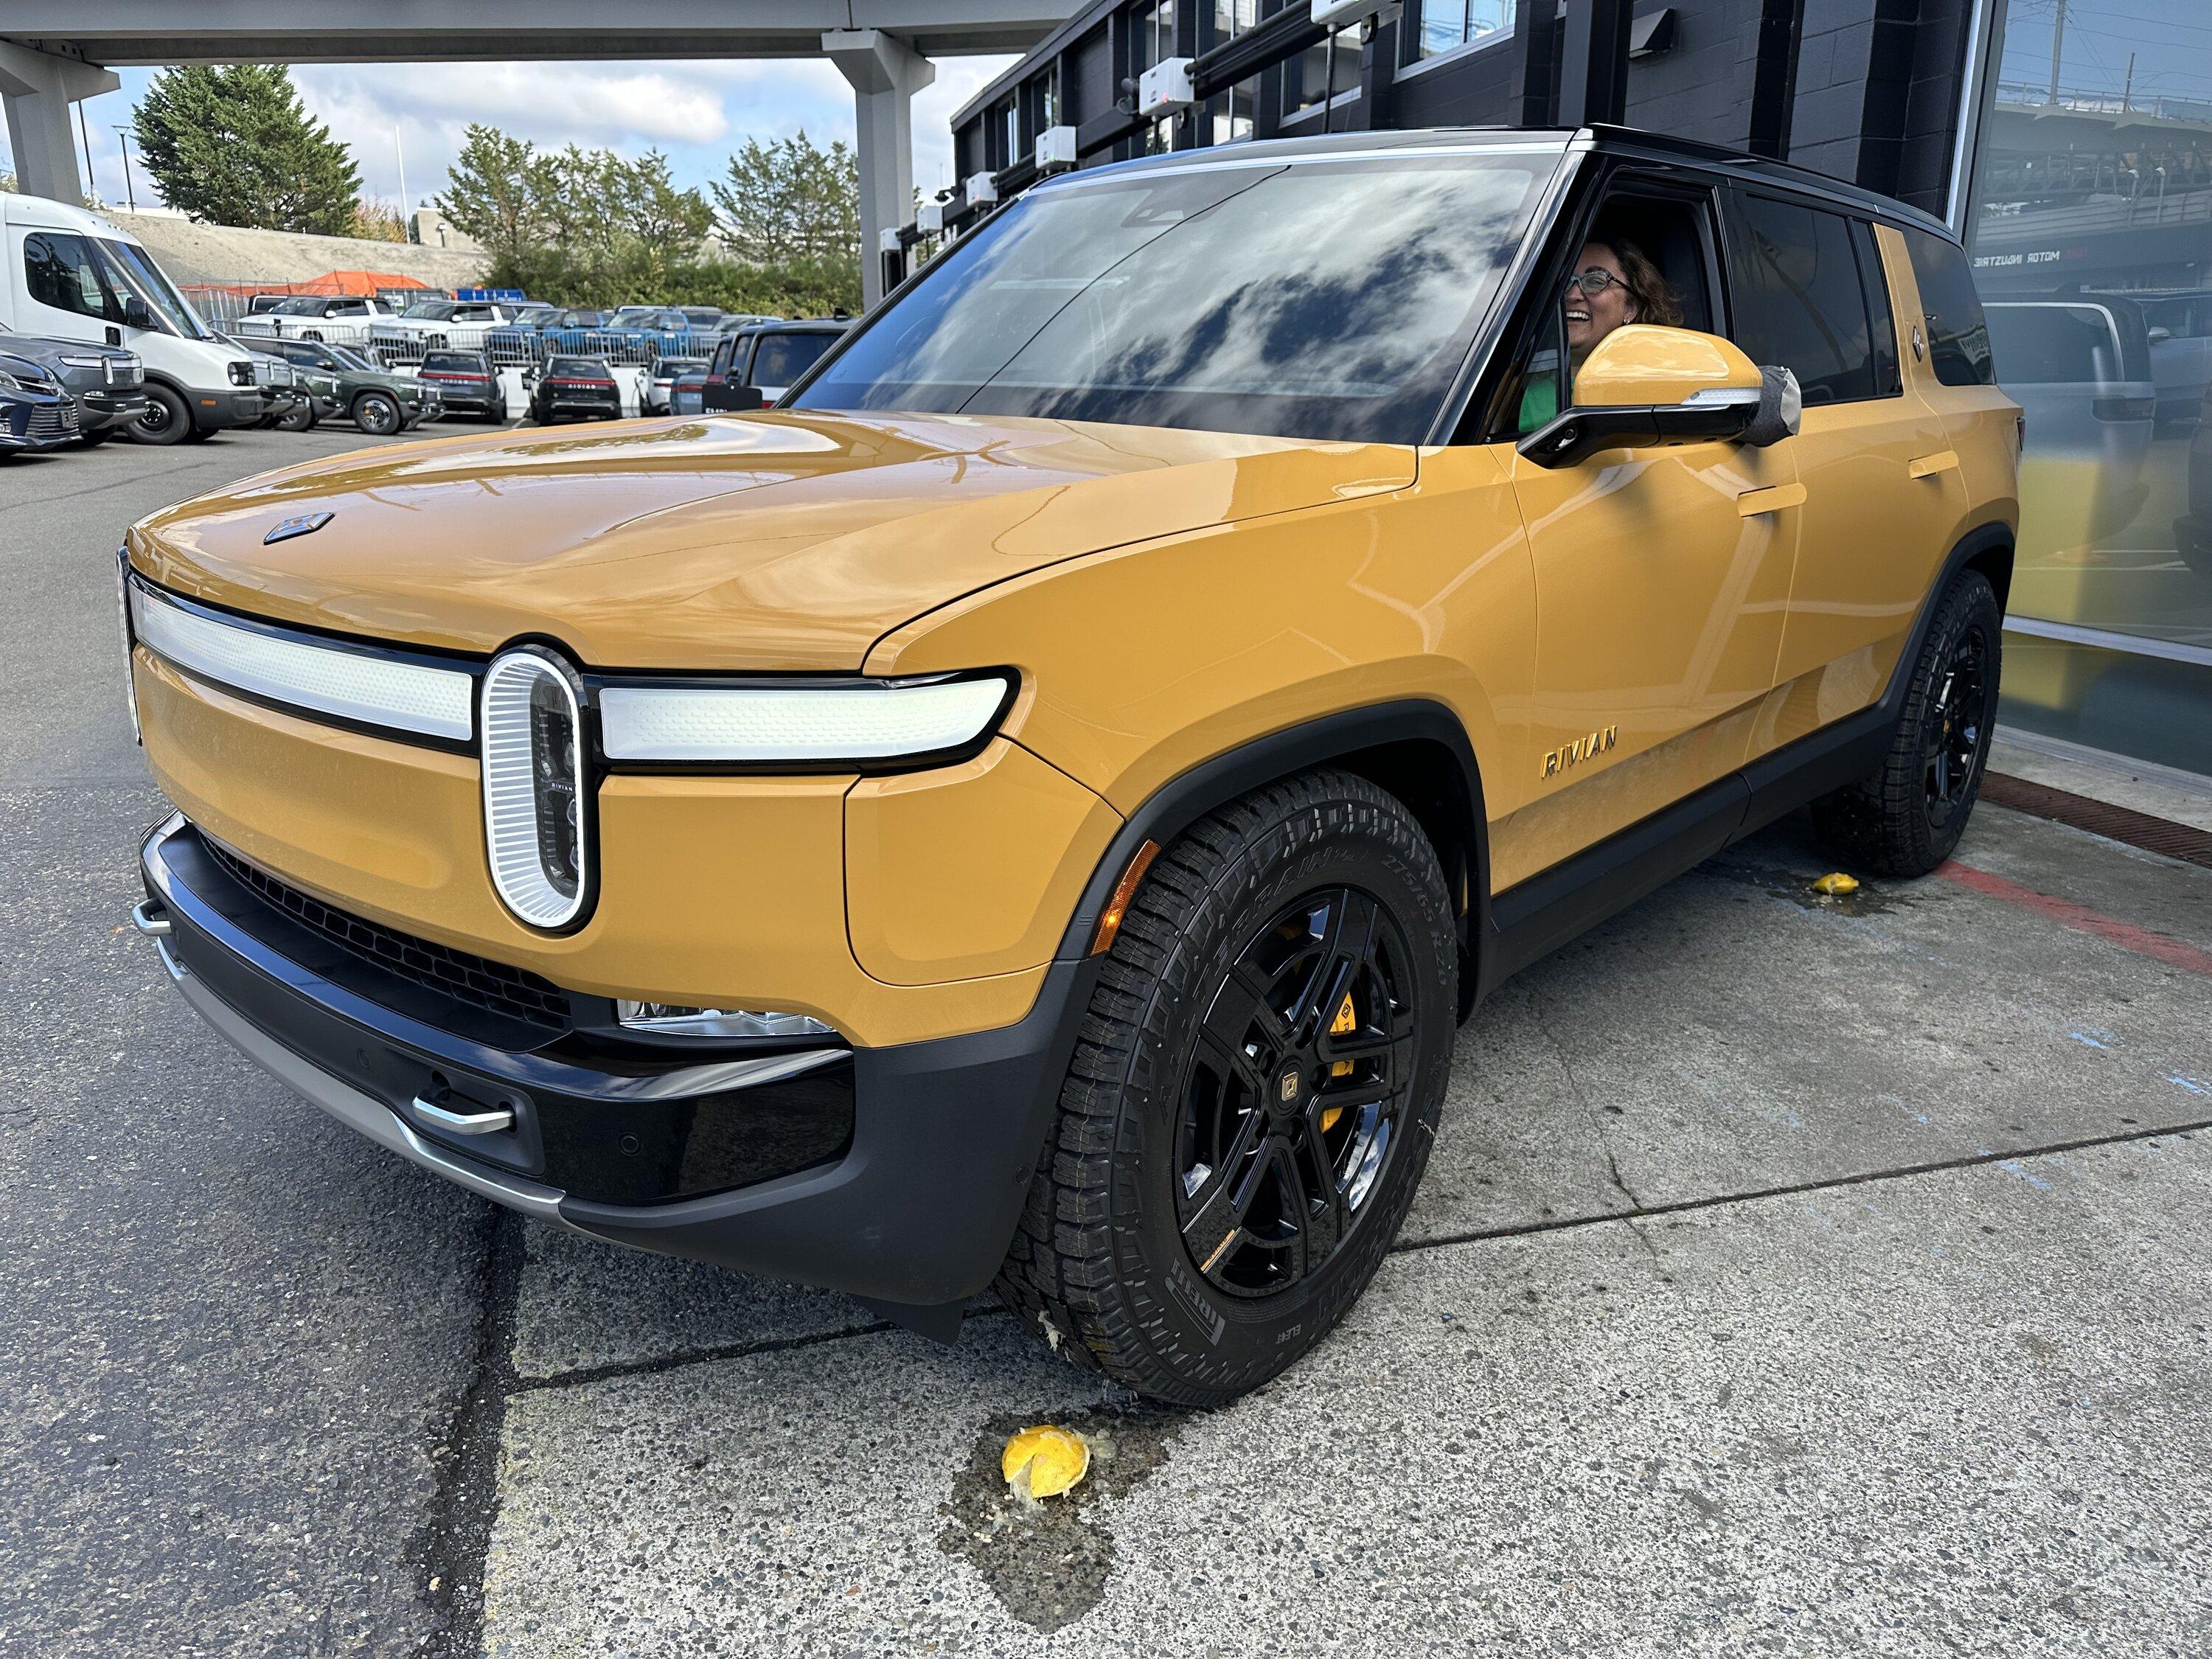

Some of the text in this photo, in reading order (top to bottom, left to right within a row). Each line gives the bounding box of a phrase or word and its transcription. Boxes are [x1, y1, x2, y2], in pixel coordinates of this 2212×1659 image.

[1540, 725, 1618, 779] RIVIAN
[552, 782, 573, 792] RIVIAN
[1164, 1256, 1225, 1346] PIRELLI
